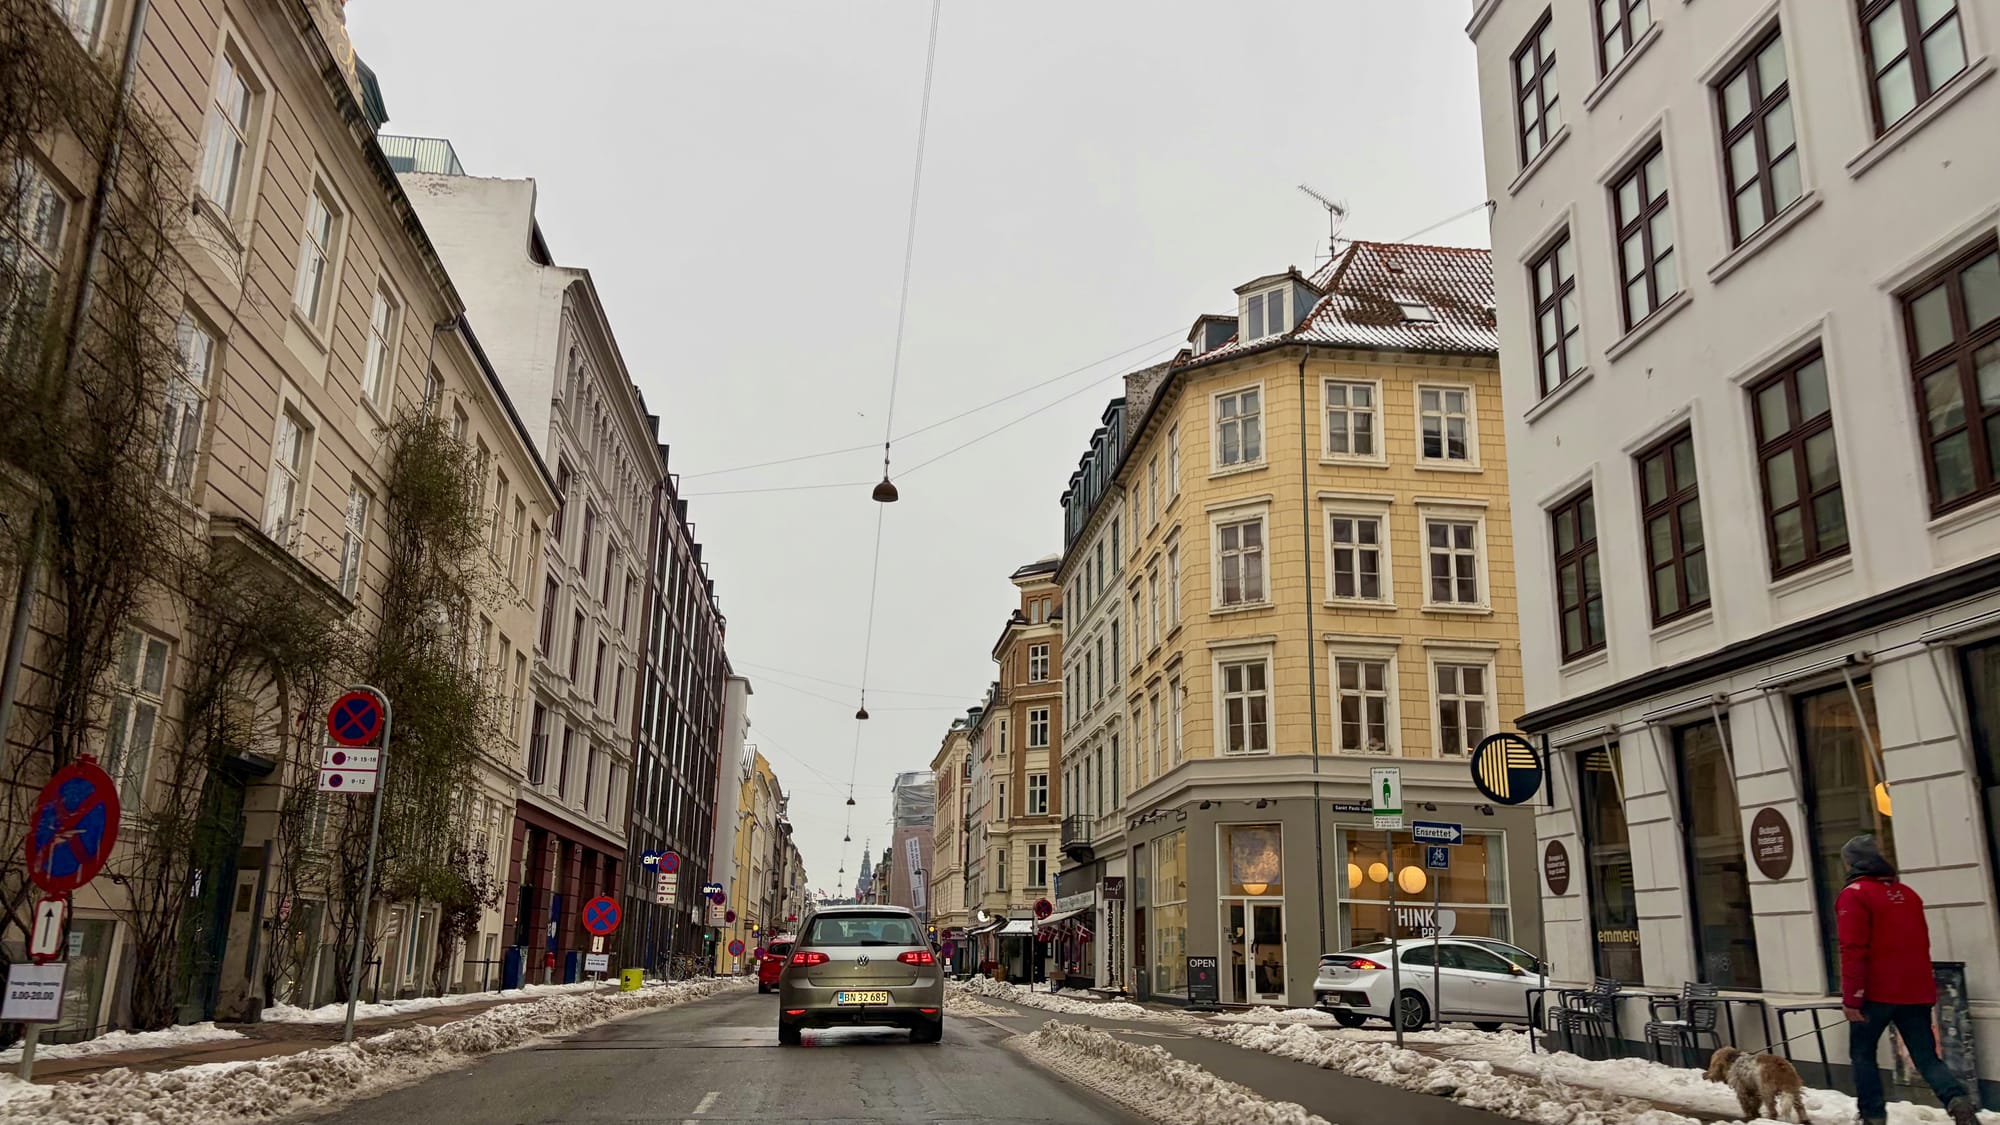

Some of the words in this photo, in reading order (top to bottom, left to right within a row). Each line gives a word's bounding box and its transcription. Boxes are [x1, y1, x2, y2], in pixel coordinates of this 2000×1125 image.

[1416, 827, 1451, 838] Ensrettet
[1189, 959, 1216, 968] OPEN
[844, 993, 857, 1001] BN
[857, 993, 868, 1001] 32
[870, 992, 886, 1001] 685
